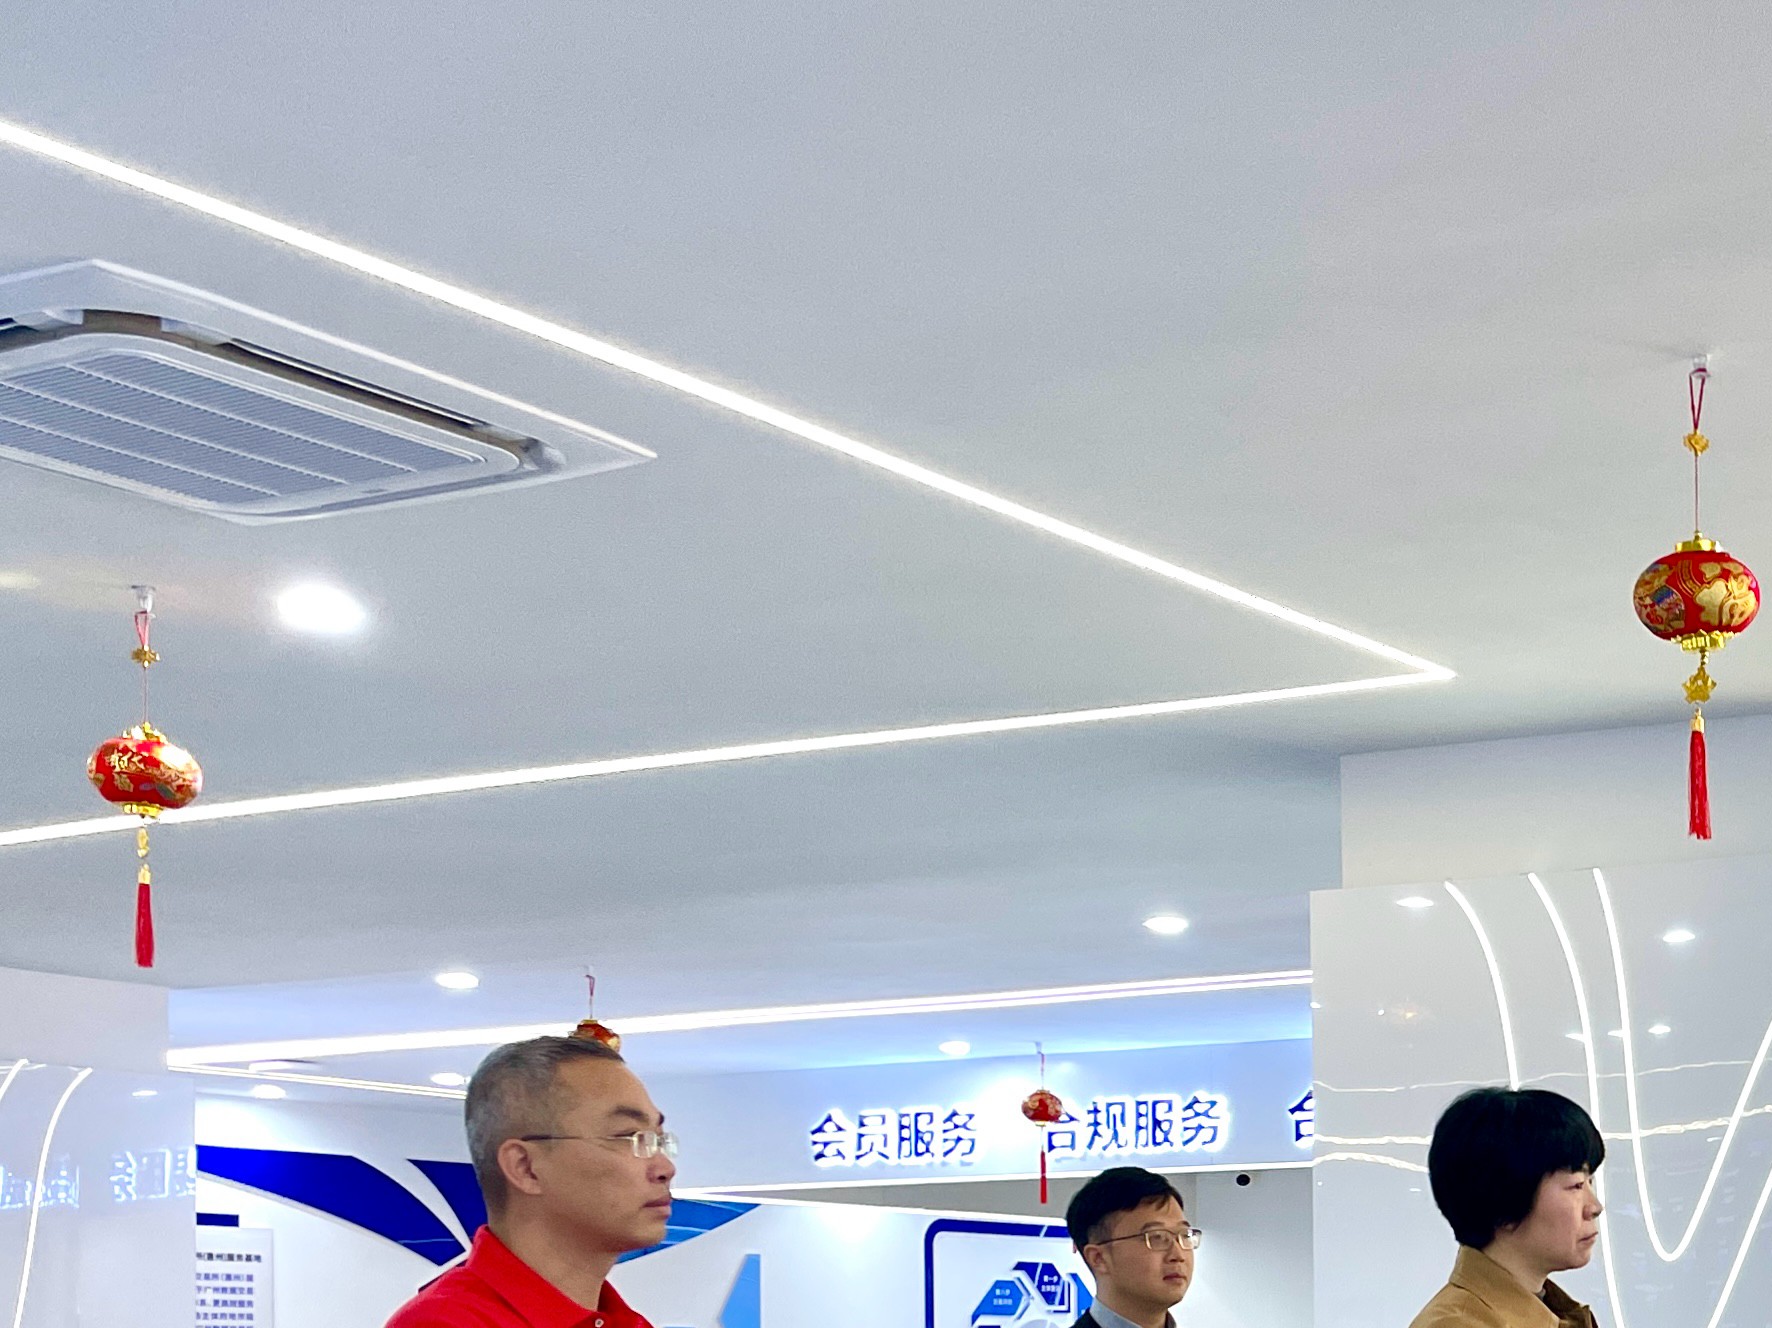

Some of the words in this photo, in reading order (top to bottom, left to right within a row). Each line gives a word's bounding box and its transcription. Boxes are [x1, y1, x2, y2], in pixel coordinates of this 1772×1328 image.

[810, 1107, 978, 1162] 会员服务
[1046, 1094, 1224, 1152] 合规服务
